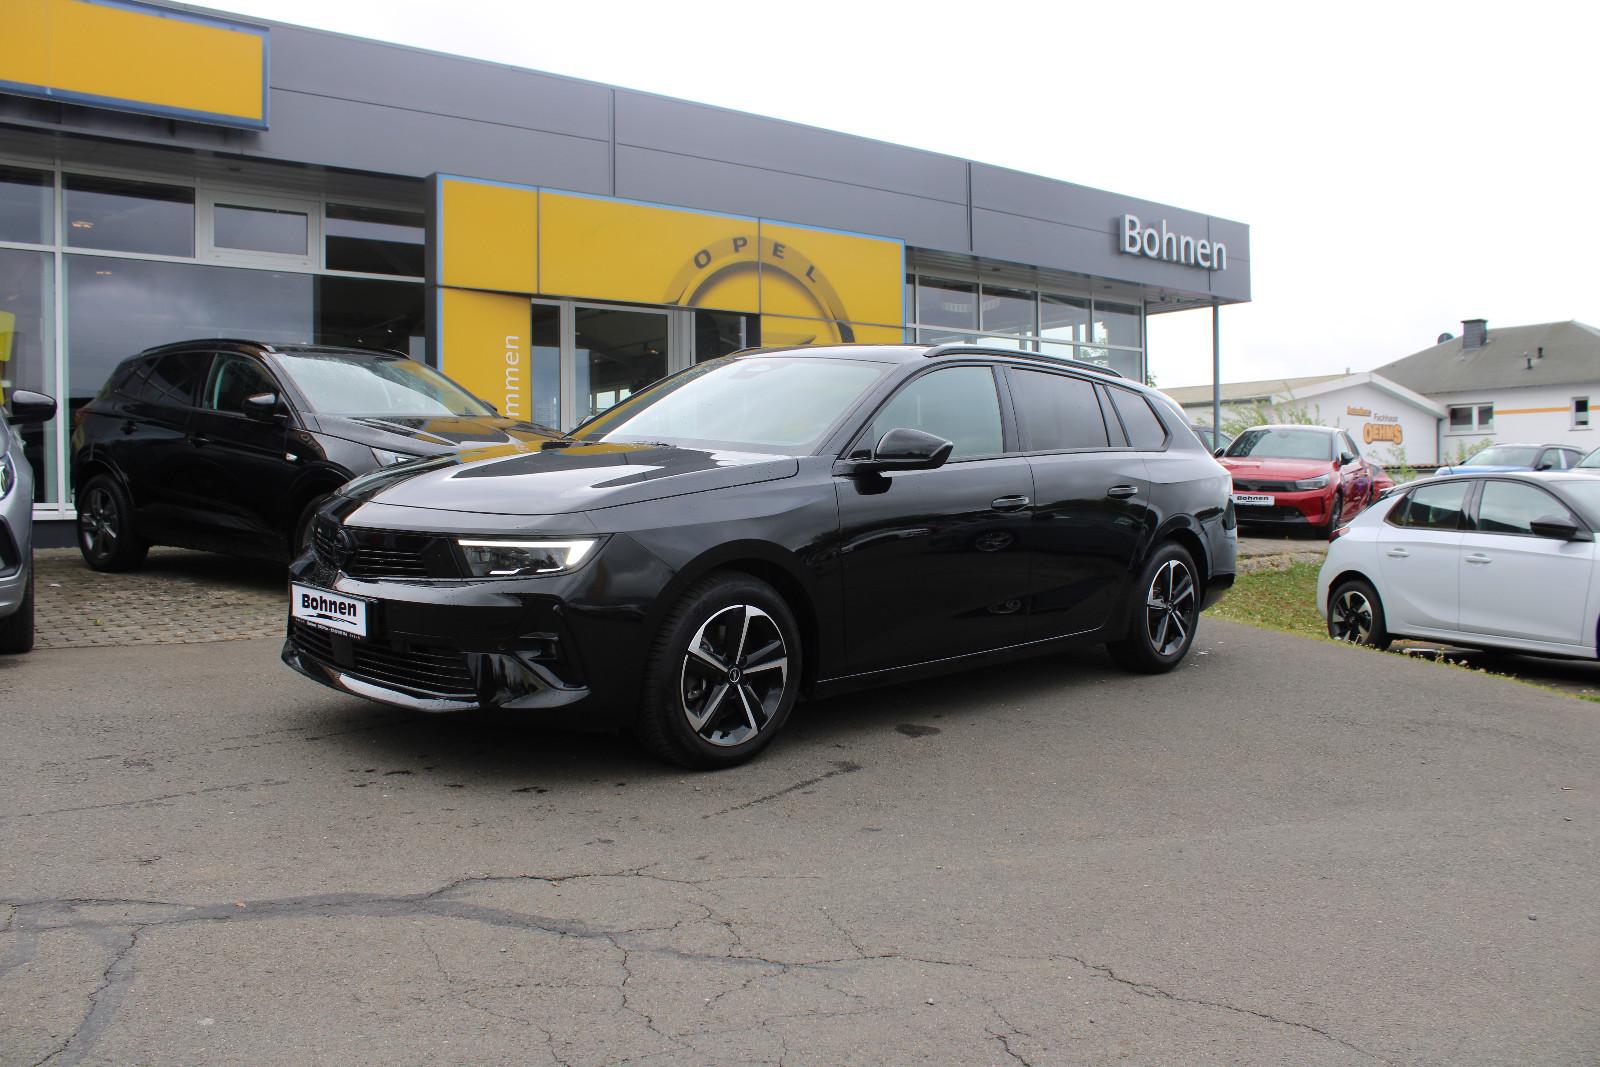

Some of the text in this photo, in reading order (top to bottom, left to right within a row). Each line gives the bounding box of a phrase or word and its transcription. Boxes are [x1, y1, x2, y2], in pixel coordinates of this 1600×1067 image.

[694, 236, 817, 283] OPEL
[1123, 213, 1227, 270] Bohnen
[302, 593, 357, 617] Bohnen
